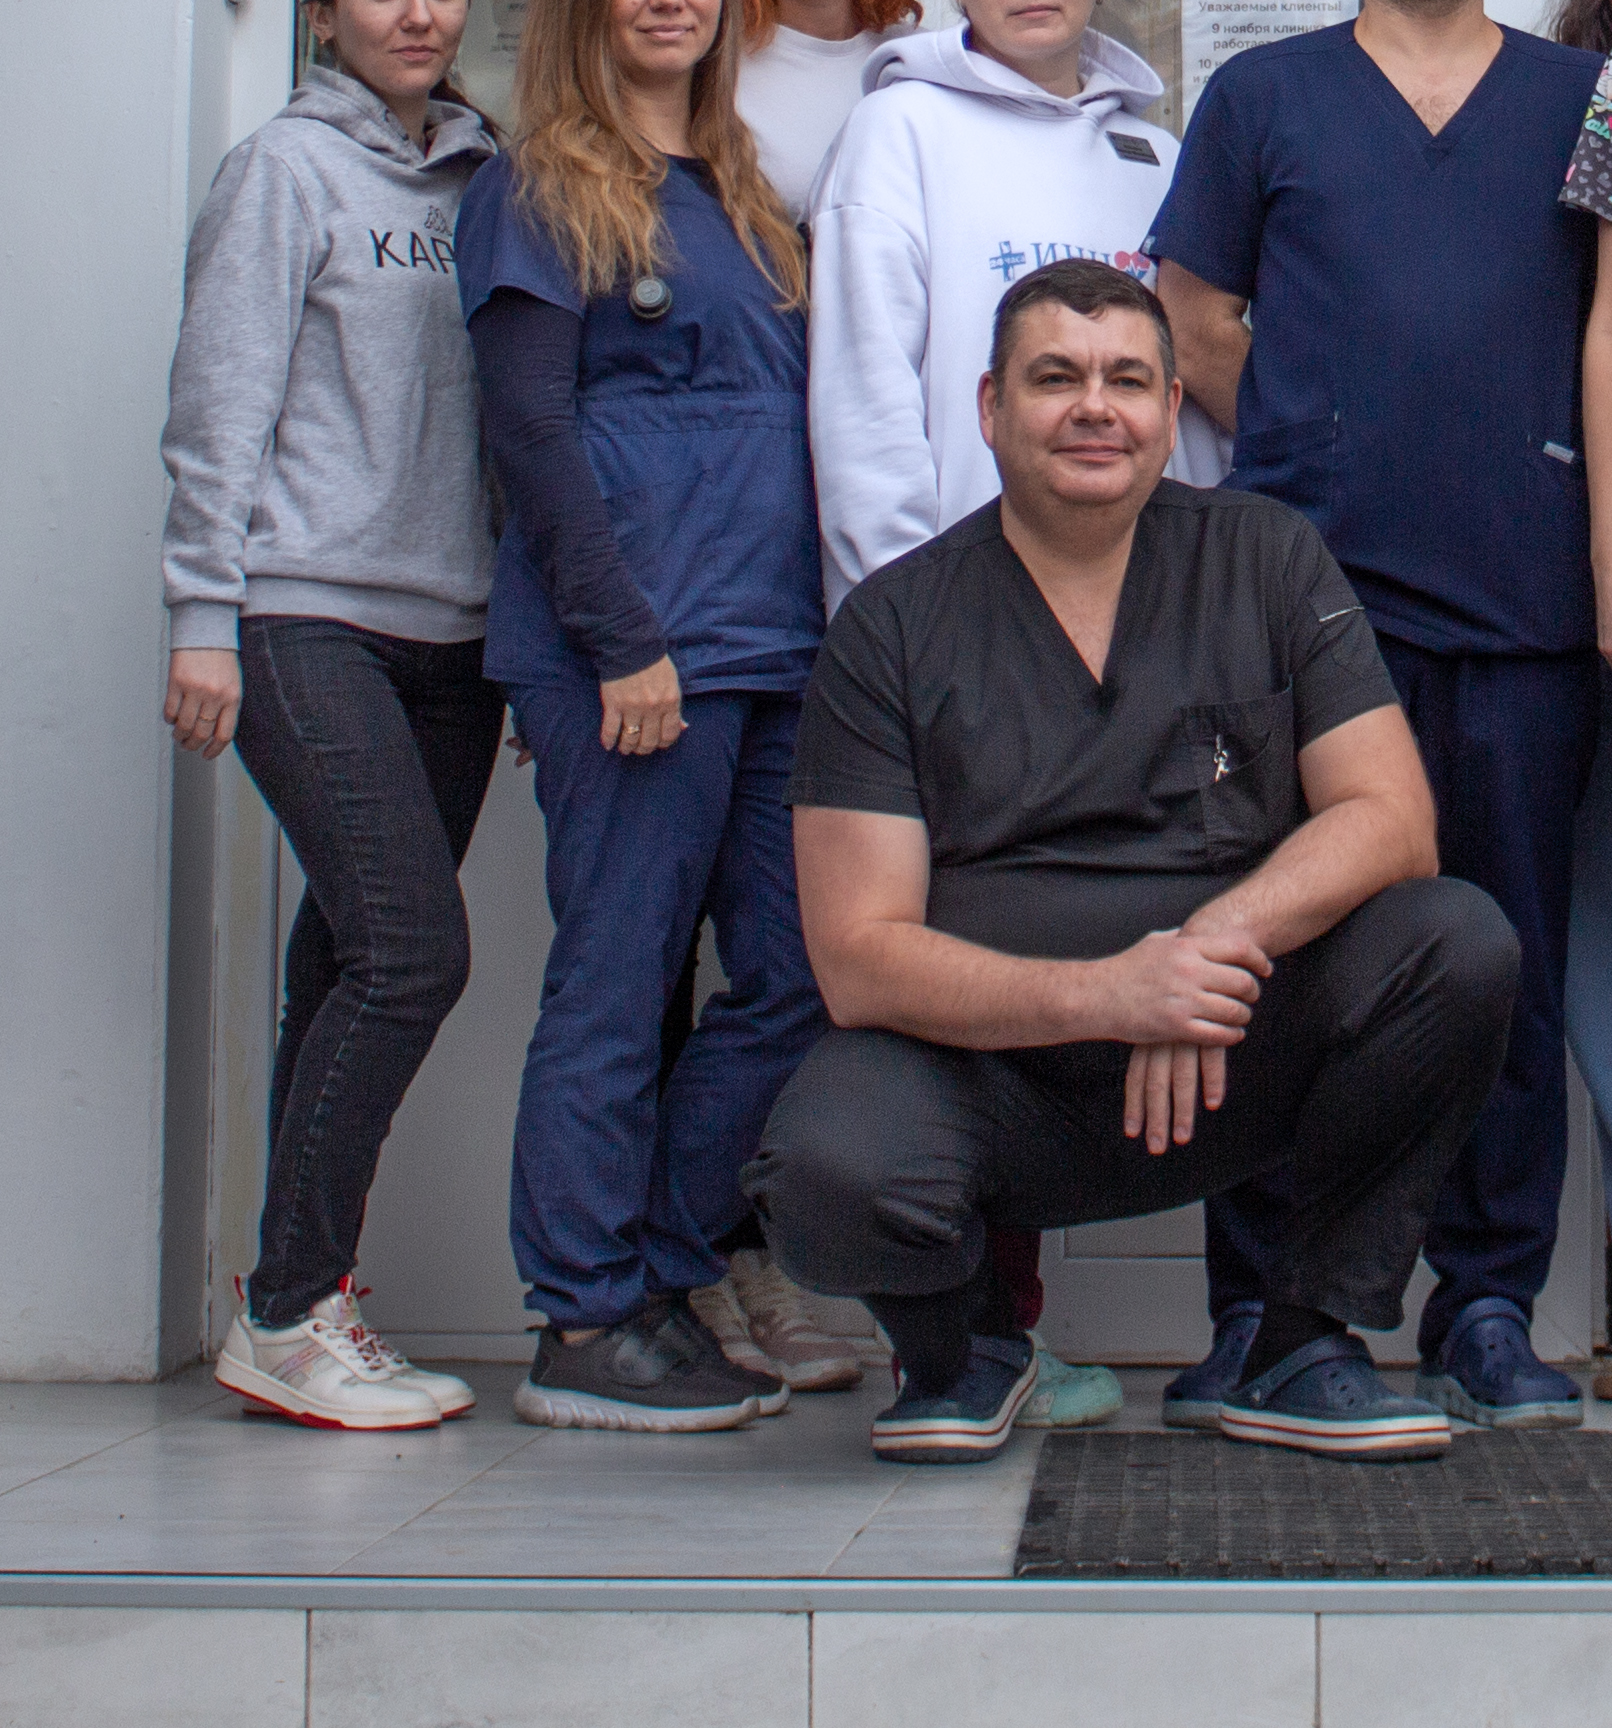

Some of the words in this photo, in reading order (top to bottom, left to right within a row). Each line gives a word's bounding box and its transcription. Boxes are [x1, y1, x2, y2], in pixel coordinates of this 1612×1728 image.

[1198, 1, 1278, 13] Уважаемые
[1280, 0, 1342, 13] клиенты!
[1211, 23, 1221, 34] 9
[1223, 22, 1271, 36] ноября
[1198, 58, 1212, 69] 10
